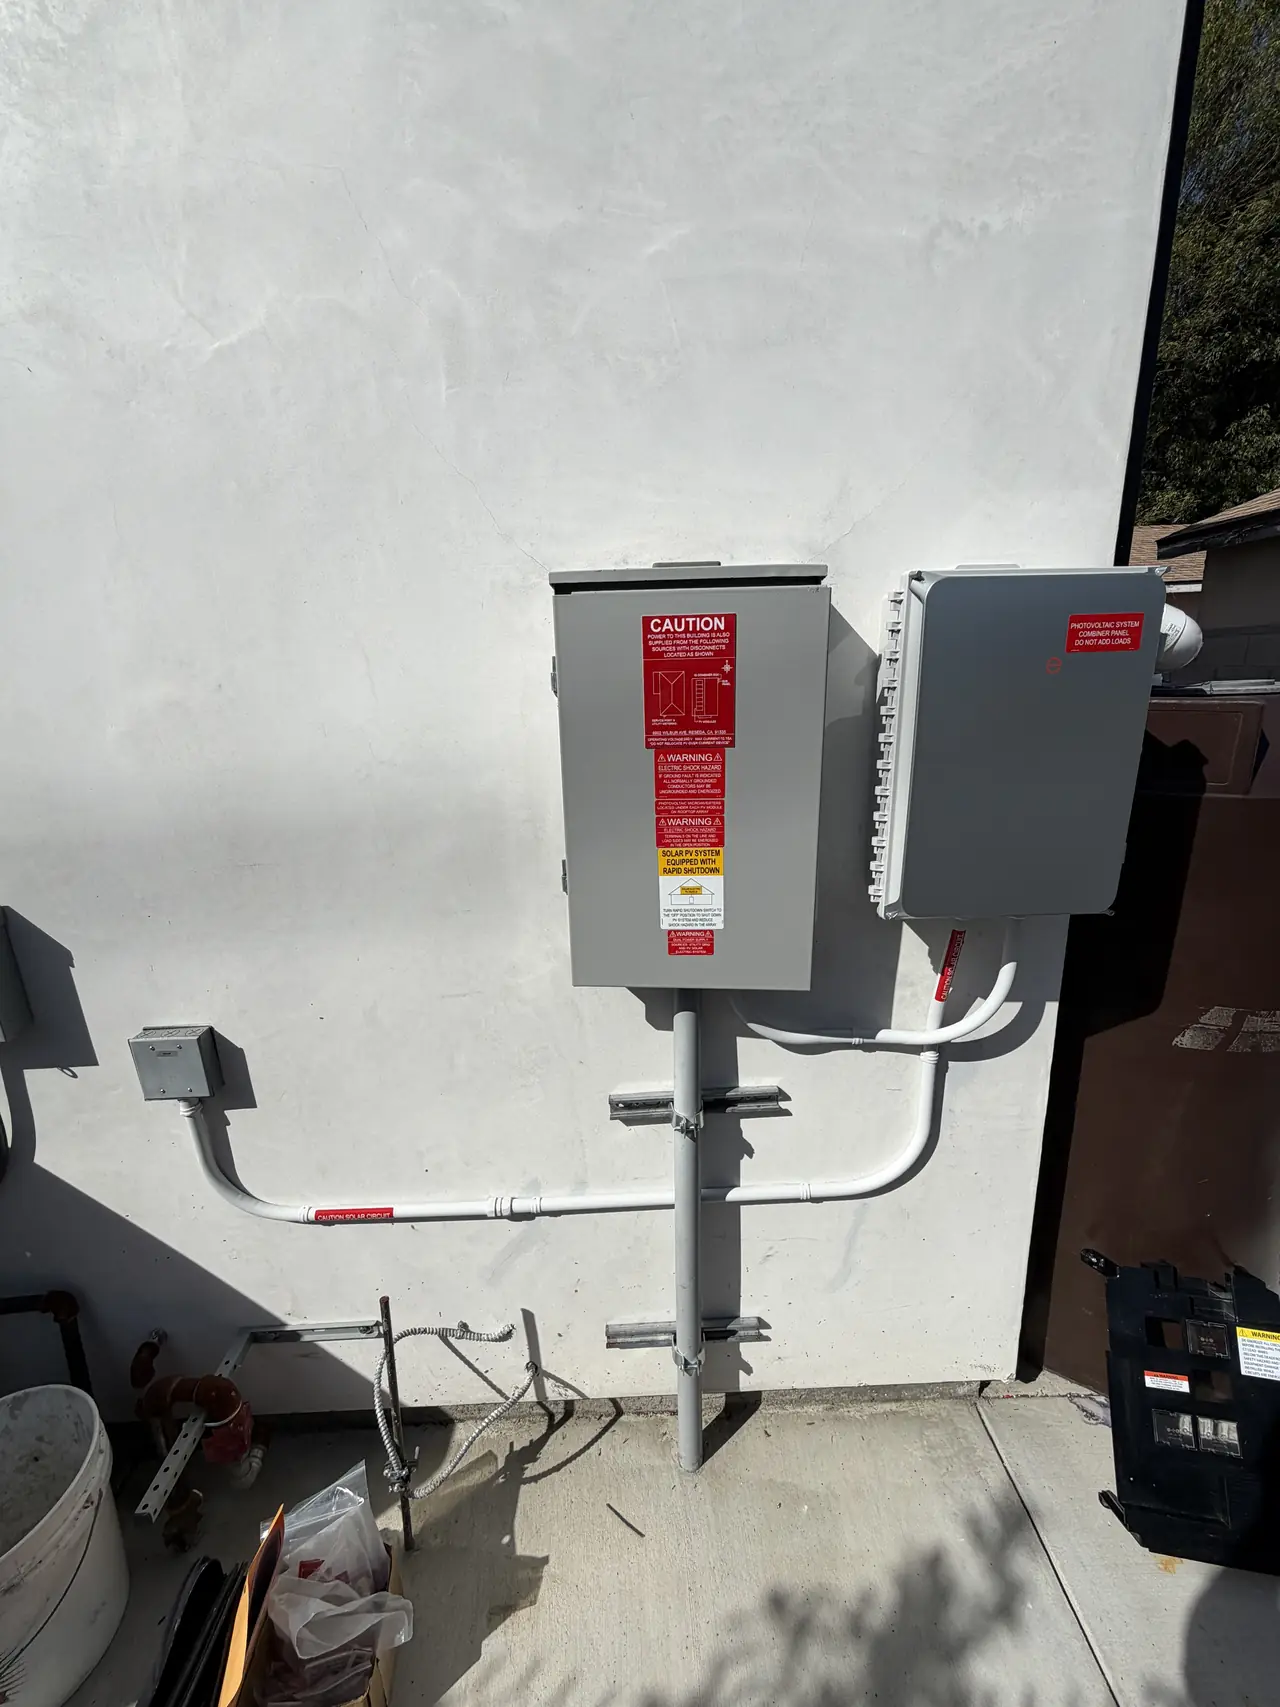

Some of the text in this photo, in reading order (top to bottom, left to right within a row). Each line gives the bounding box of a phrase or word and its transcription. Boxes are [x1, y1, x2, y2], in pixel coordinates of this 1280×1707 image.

[650, 616, 725, 632] CAUTION
[1071, 622, 1114, 630] PHOTOVOLTAIC
[1079, 630, 1110, 638] COMBINER
